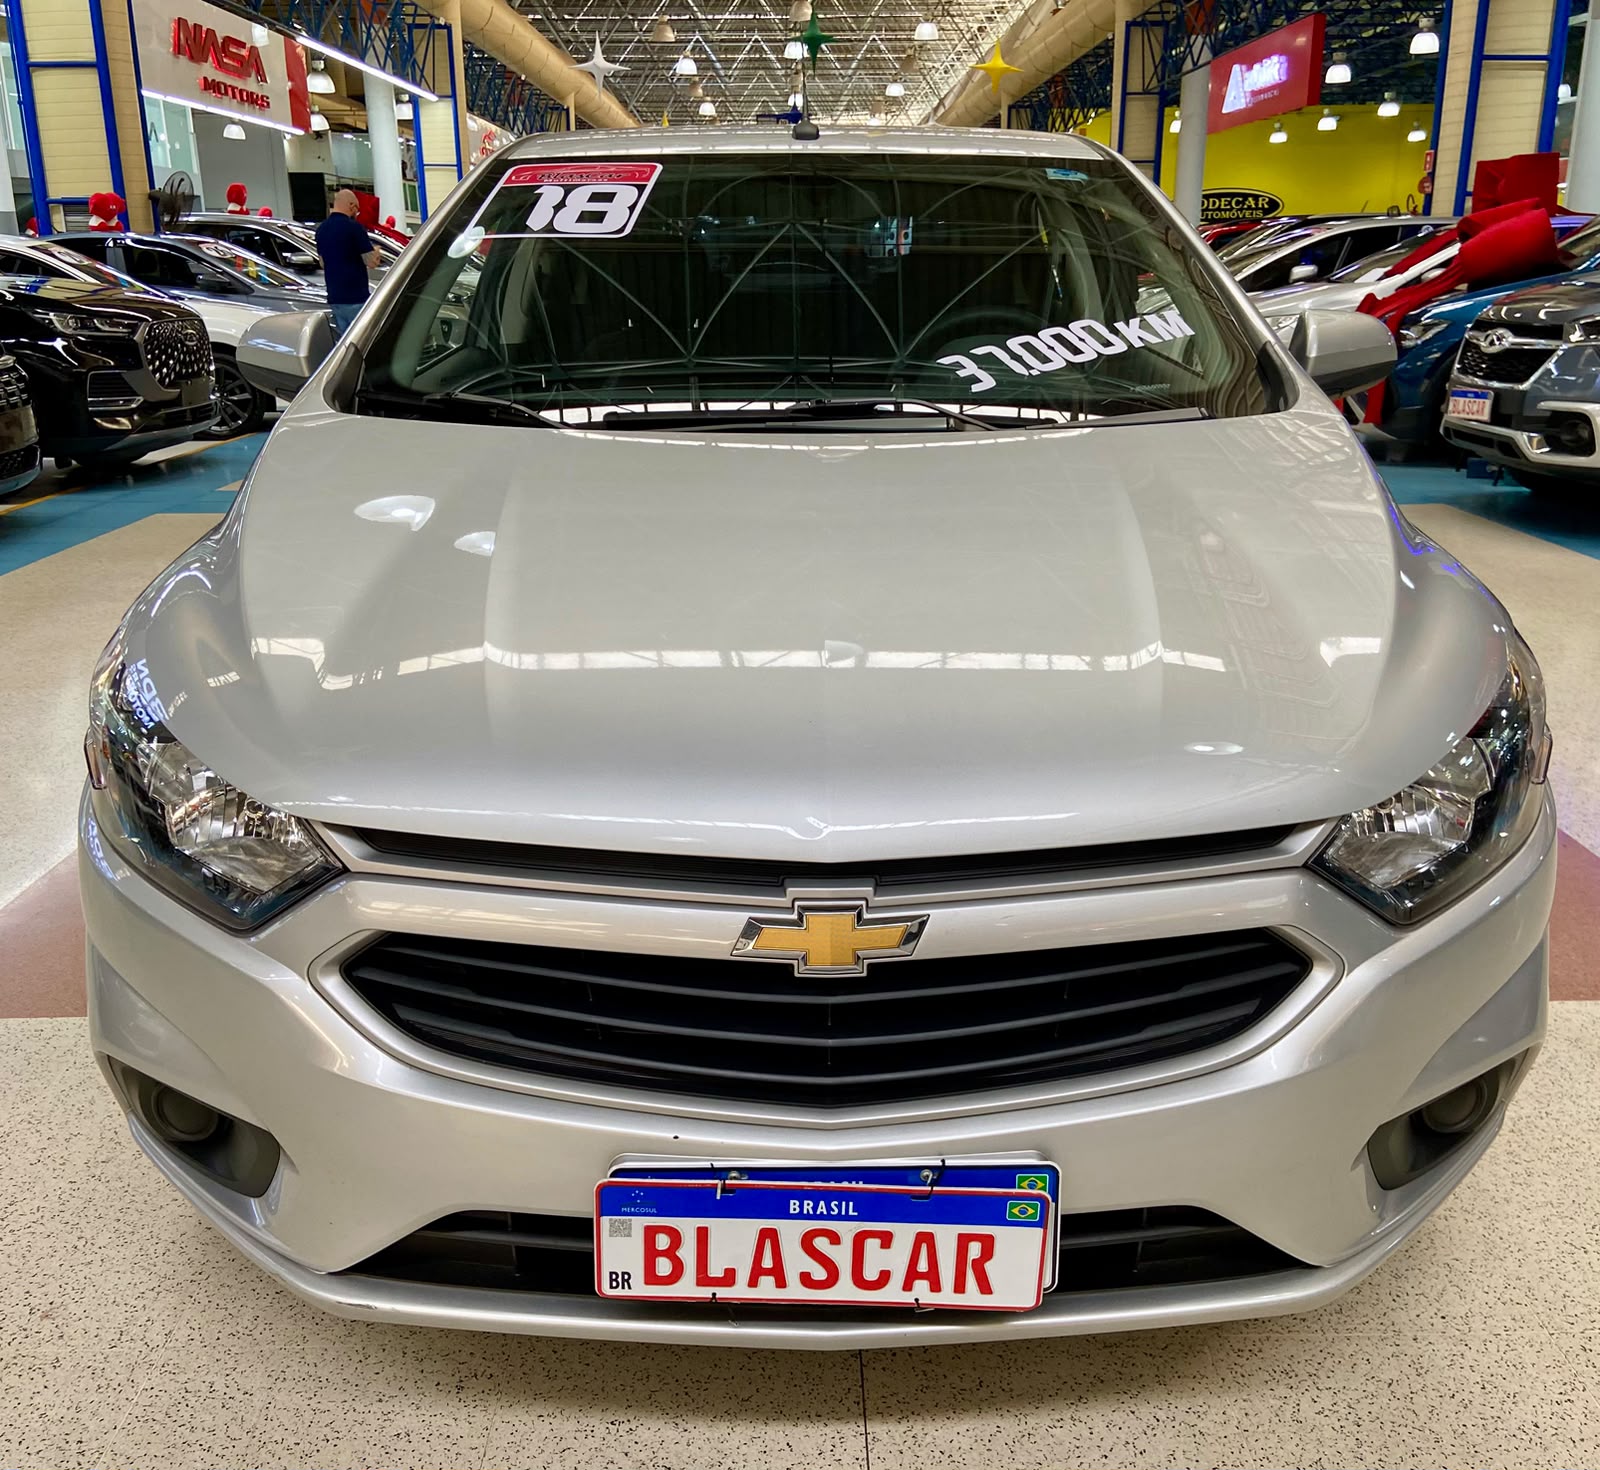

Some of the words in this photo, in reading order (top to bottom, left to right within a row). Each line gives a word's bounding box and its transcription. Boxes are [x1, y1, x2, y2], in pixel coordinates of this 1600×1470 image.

[171, 17, 268, 84] NASA
[199, 76, 271, 111] MOTORS
[525, 185, 639, 234] 18
[789, 1199, 859, 1217] BRASIL
[608, 1271, 632, 1290] BR
[642, 1224, 996, 1296] BLASCAR
